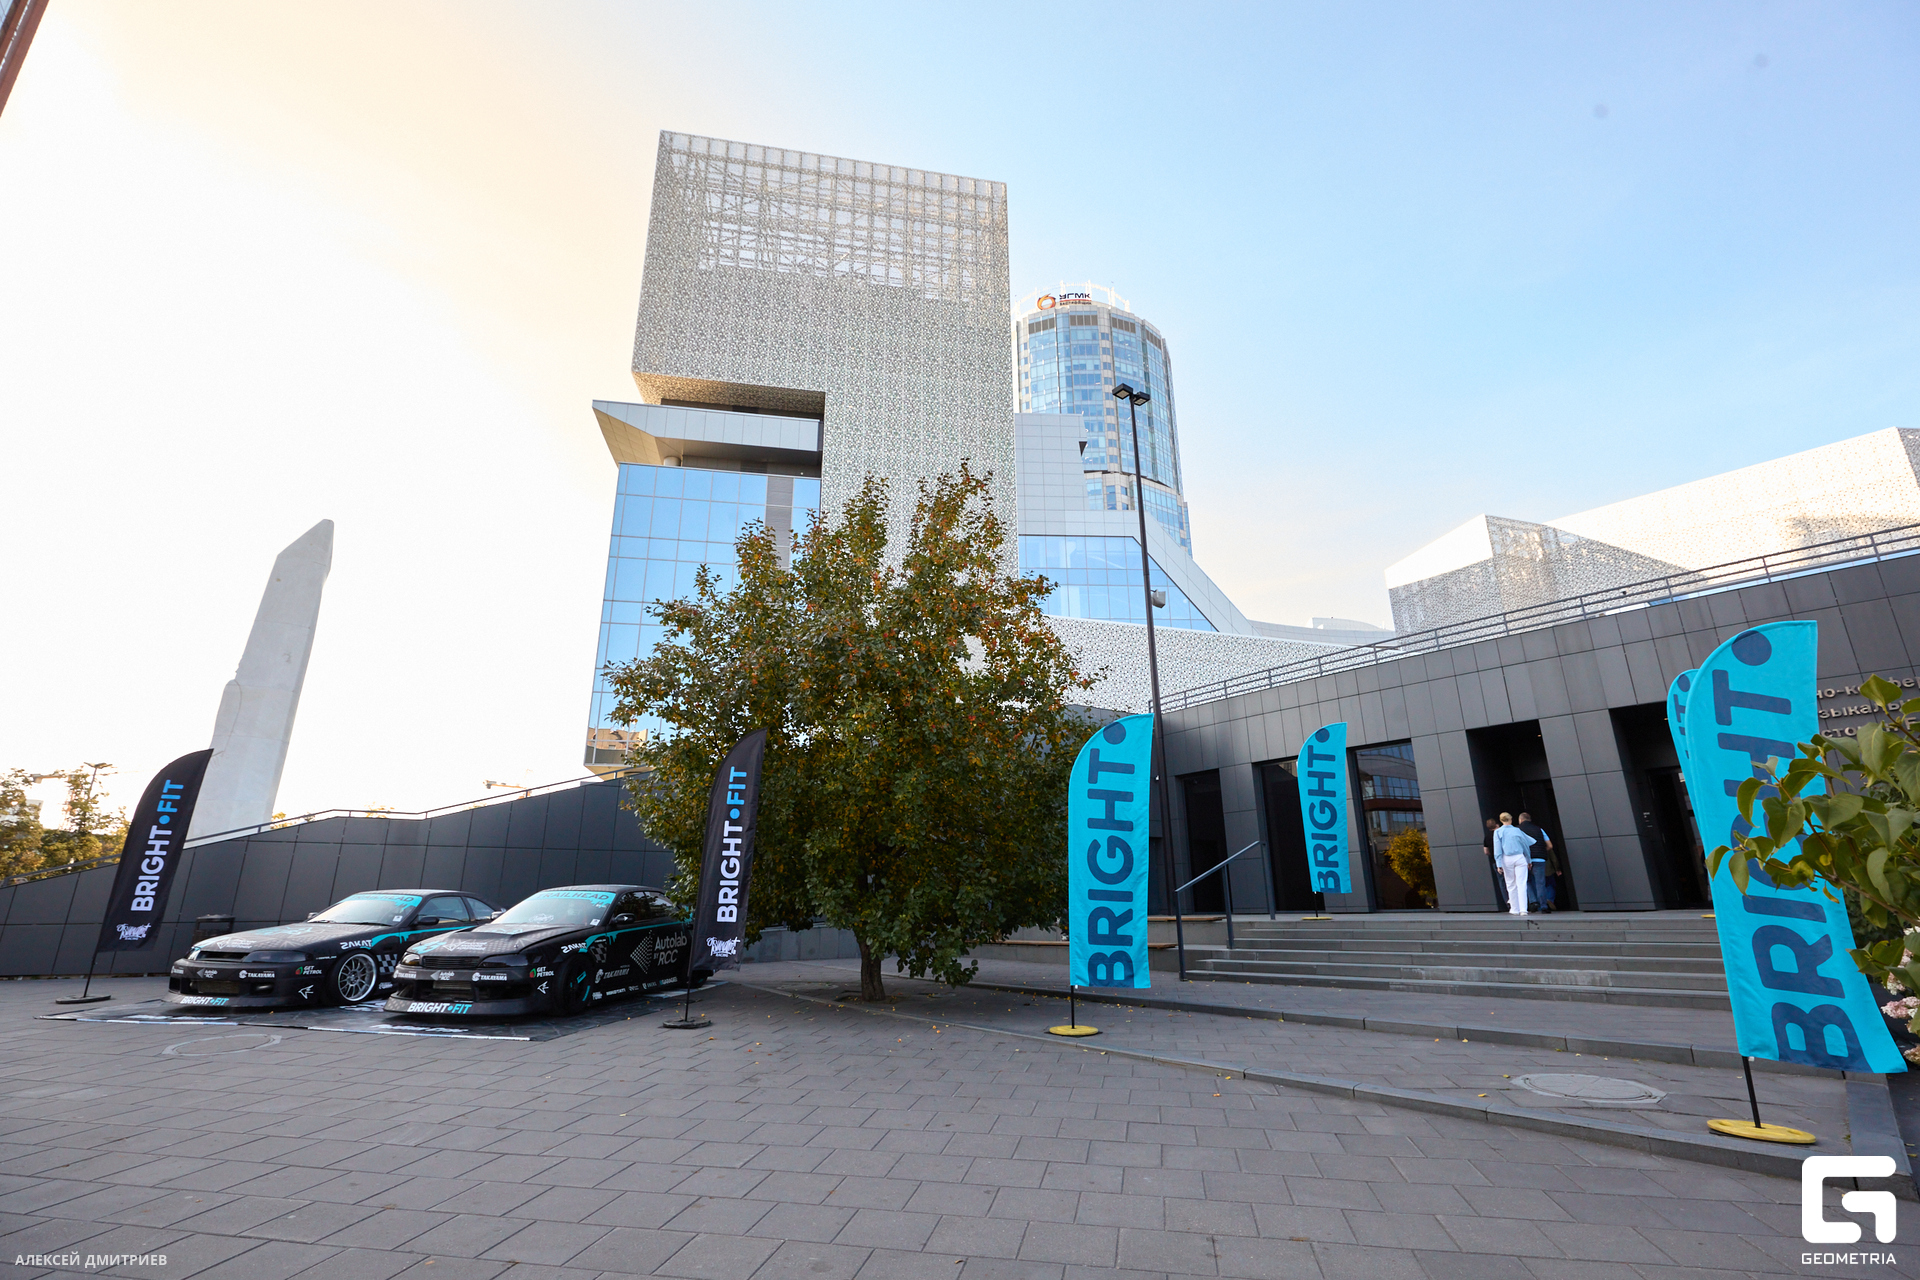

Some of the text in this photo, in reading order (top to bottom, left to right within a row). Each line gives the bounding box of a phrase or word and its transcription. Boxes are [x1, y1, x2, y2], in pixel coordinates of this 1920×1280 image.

[1059, 292, 1091, 300] УГМК
[1307, 744, 1340, 893] BRIGHT
[1087, 748, 1135, 987] BRIGHT
[654, 932, 688, 951] Autolab
[657, 949, 678, 966] RCC
